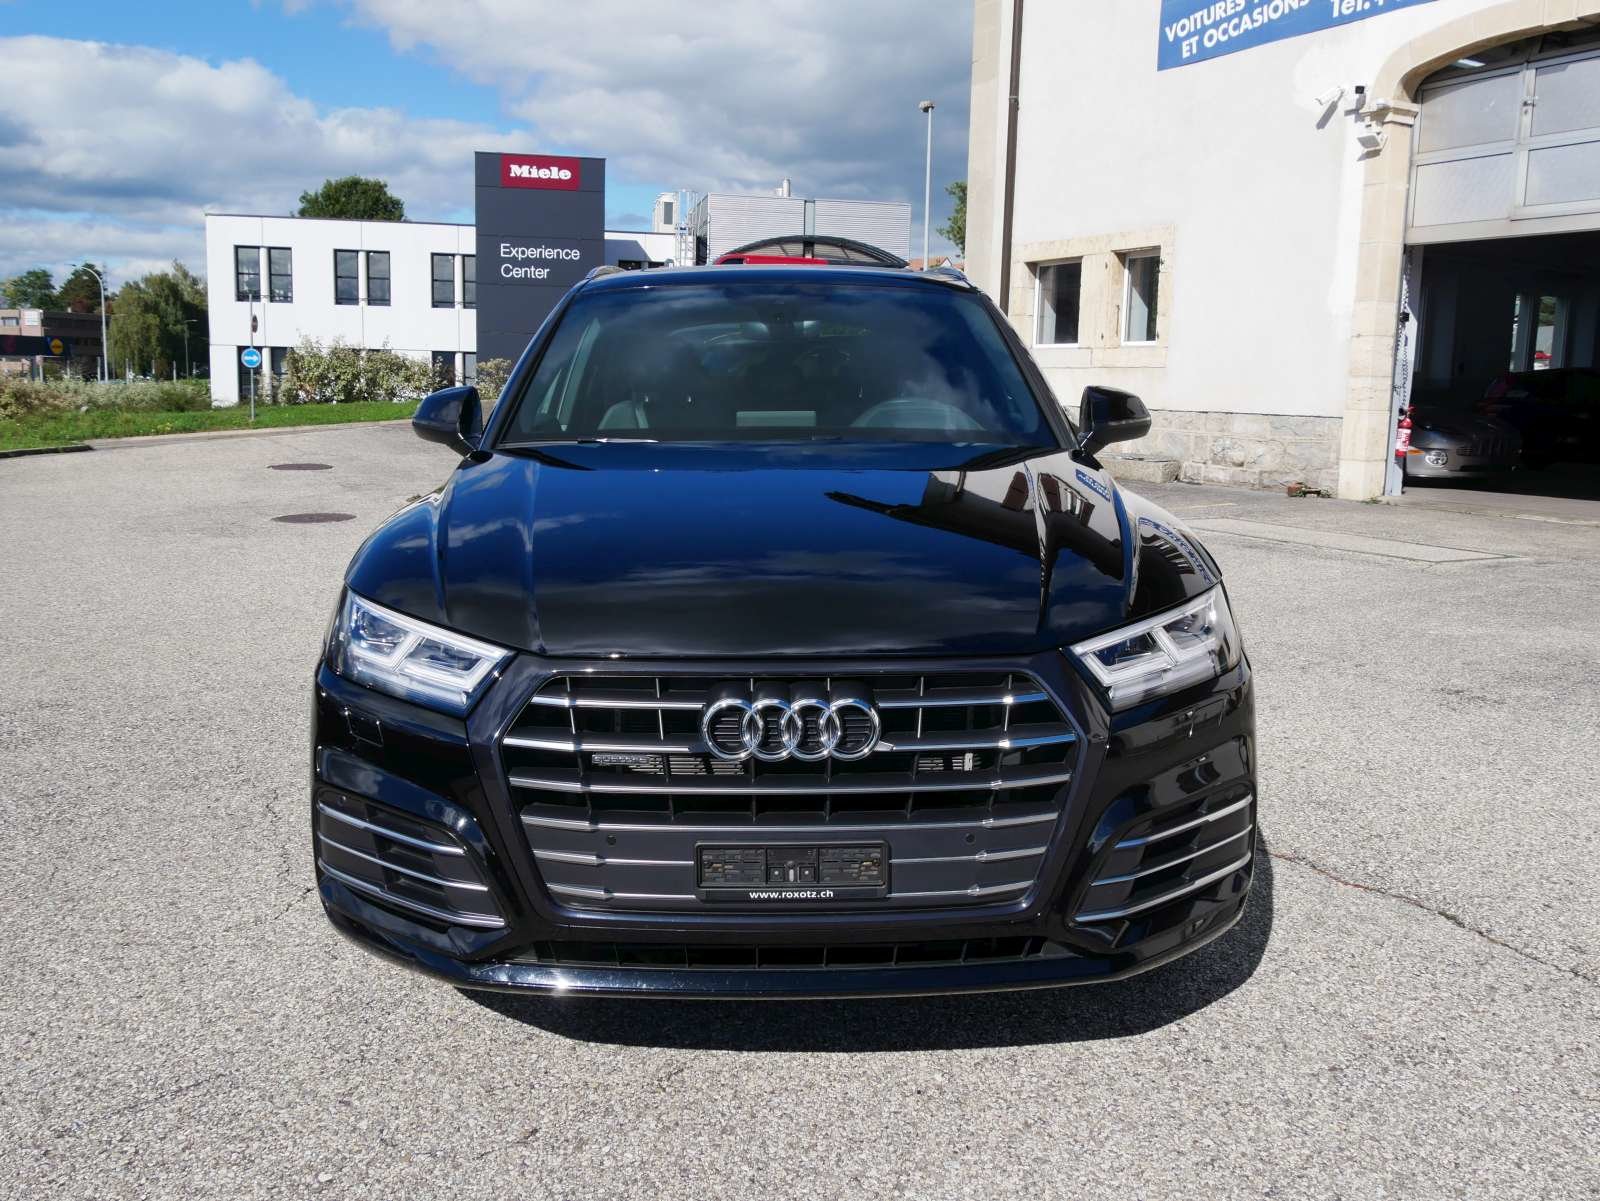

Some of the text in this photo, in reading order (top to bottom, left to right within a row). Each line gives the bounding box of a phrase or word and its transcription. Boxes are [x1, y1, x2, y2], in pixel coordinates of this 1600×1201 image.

[1164, 0, 1246, 42] VOITURES
[1182, 35, 1200, 59] ET
[509, 164, 572, 180] Miele
[500, 243, 581, 261] Experience
[500, 263, 550, 279] Center
[749, 889, 834, 899] www.roxotz.ch
